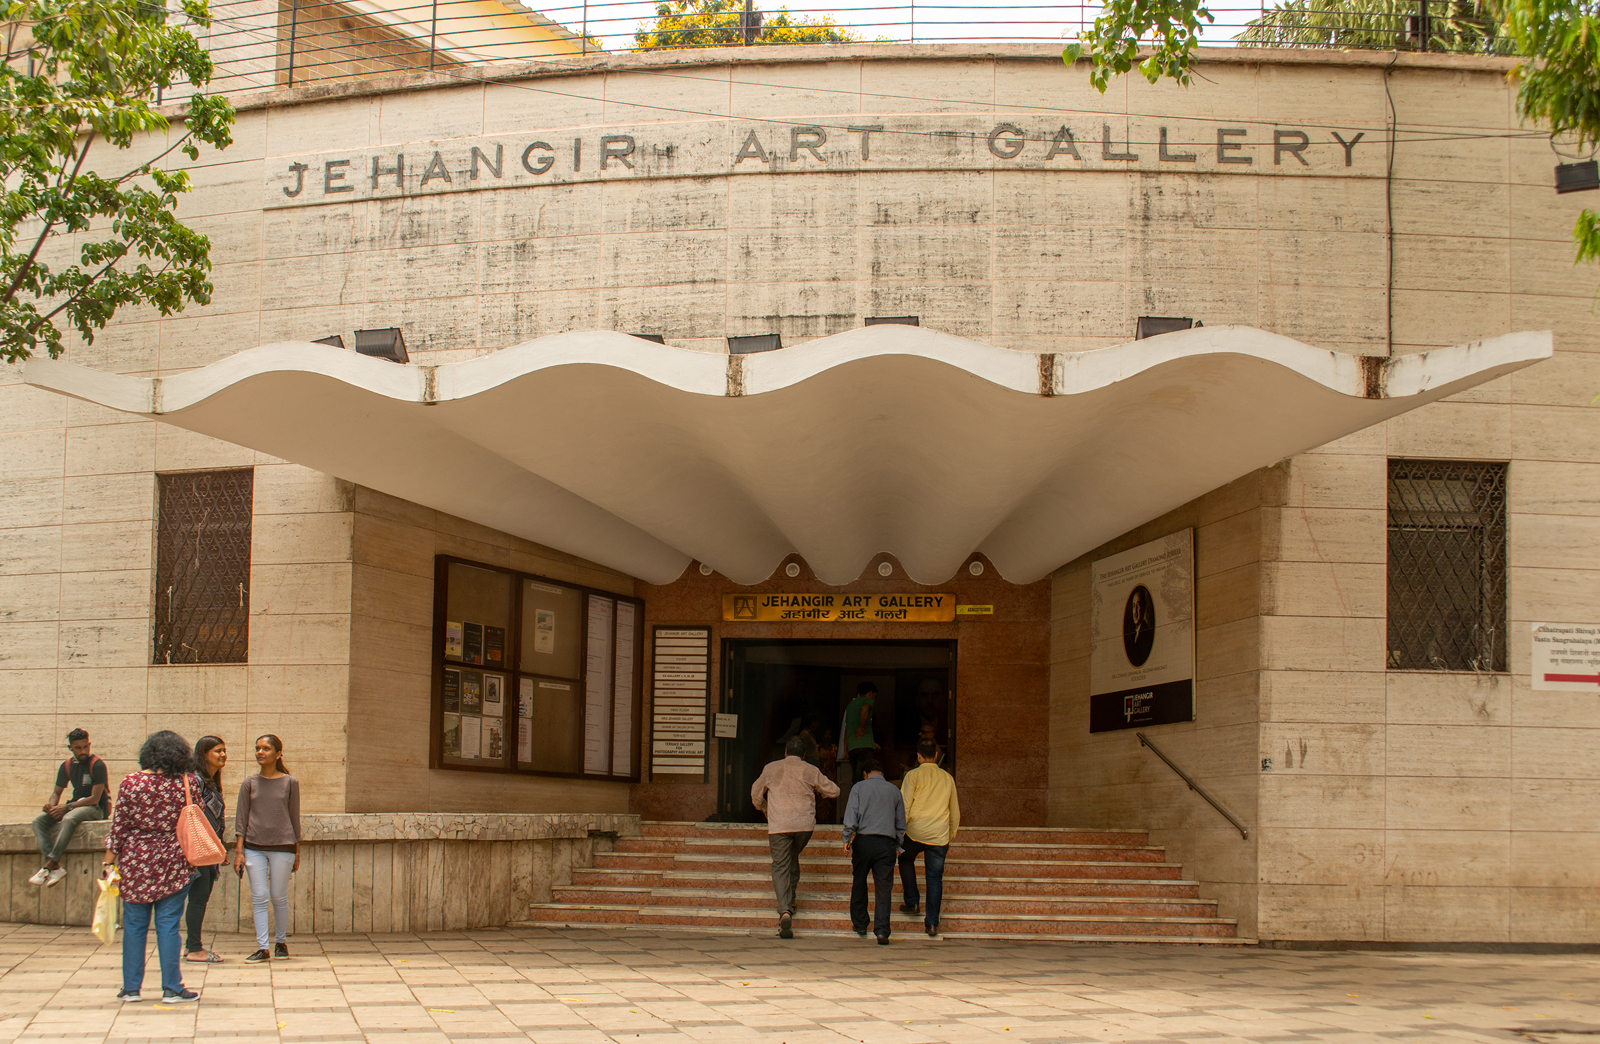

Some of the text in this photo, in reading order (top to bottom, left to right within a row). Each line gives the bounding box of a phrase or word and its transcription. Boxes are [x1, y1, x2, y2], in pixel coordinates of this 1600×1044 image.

[282, 123, 1365, 198] JEHANGIR ART GALLERY
[1132, 560, 1148, 570] GALLERY
[762, 596, 944, 608] JEHANGIR ART GALLERY
[838, 608, 867, 619] आर्ट
[1134, 692, 1154, 700] JEHANGIR
[1134, 706, 1150, 714] GALLERY
